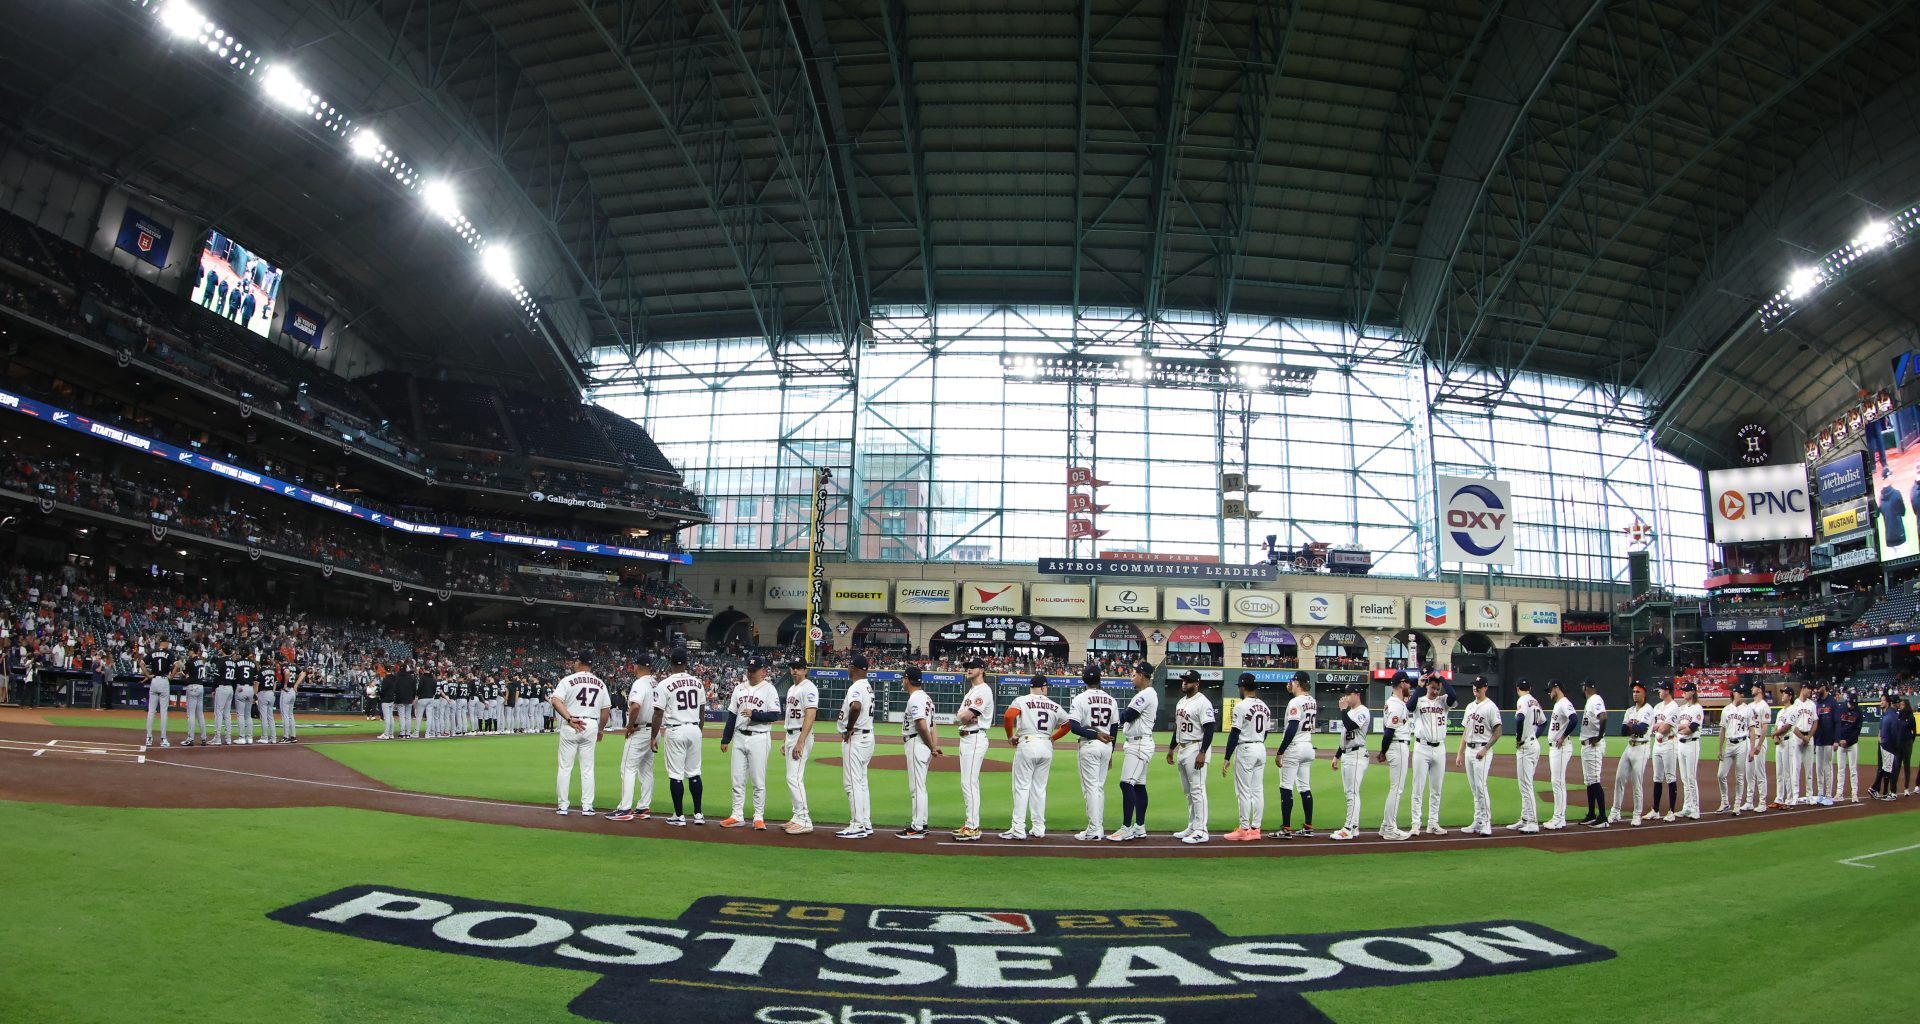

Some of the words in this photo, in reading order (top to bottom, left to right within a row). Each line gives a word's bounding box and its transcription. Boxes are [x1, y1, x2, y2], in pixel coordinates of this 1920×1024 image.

[1737, 424, 1767, 438] HOUSTON
[1746, 436, 1761, 452] H
[1742, 453, 1768, 464] ASTROS
[1072, 471, 1086, 482] 05
[1227, 477, 1239, 488] 17
[1822, 468, 1861, 491] Methodist
[547, 494, 586, 508] Gallagher
[587, 500, 607, 509] Club
[1073, 497, 1086, 508] 19
[1747, 489, 1806, 516] PNC
[1227, 504, 1239, 514] 22
[813, 489, 828, 554] CHIKIN
[1447, 509, 1507, 530] OXY
[1828, 514, 1855, 530] MUSTANG
[1072, 522, 1084, 533] 21
[1169, 554, 1200, 562] PARK
[812, 556, 825, 577] IZ
[1049, 561, 1103, 572] ASTROS
[1110, 562, 1199, 575] COMMUNITY
[1206, 566, 1267, 578] LEADERS
[781, 589, 809, 597] CALPIN
[835, 591, 883, 600] DOGGETT
[901, 588, 951, 597] CHENIERE
[811, 580, 824, 626] FAIR
[1190, 594, 1211, 607] slb
[969, 604, 1015, 613] ConocoPhillips
[1105, 605, 1150, 614] LEXUS
[1360, 603, 1394, 615] reliant
[1532, 611, 1558, 625] LNG
[1797, 615, 1826, 625] PLUCKERS
[1563, 621, 1610, 632] Budweiser
[1257, 630, 1280, 638] planet
[1260, 635, 1284, 643] fitness
[1329, 633, 1345, 641] SPACE
[1345, 633, 1357, 642] CITY
[158, 658, 162, 672] 1
[225, 668, 235, 680] 20
[243, 667, 250, 679] 5
[568, 676, 605, 690] RODRIGUEZ
[666, 679, 702, 693] CAUFIELD
[576, 687, 600, 707] 47
[676, 689, 698, 711] 90
[1087, 696, 1113, 706] JAVIER
[790, 708, 802, 719] 35
[1090, 707, 1112, 727] 53
[1037, 711, 1049, 731] 2
[1255, 714, 1264, 733] 0
[1181, 722, 1194, 733] 30
[1474, 725, 1485, 735] 58
[1737, 723, 1746, 732] 74
[718, 901, 845, 923] 20
[309, 889, 1583, 990] POSTSEASON
